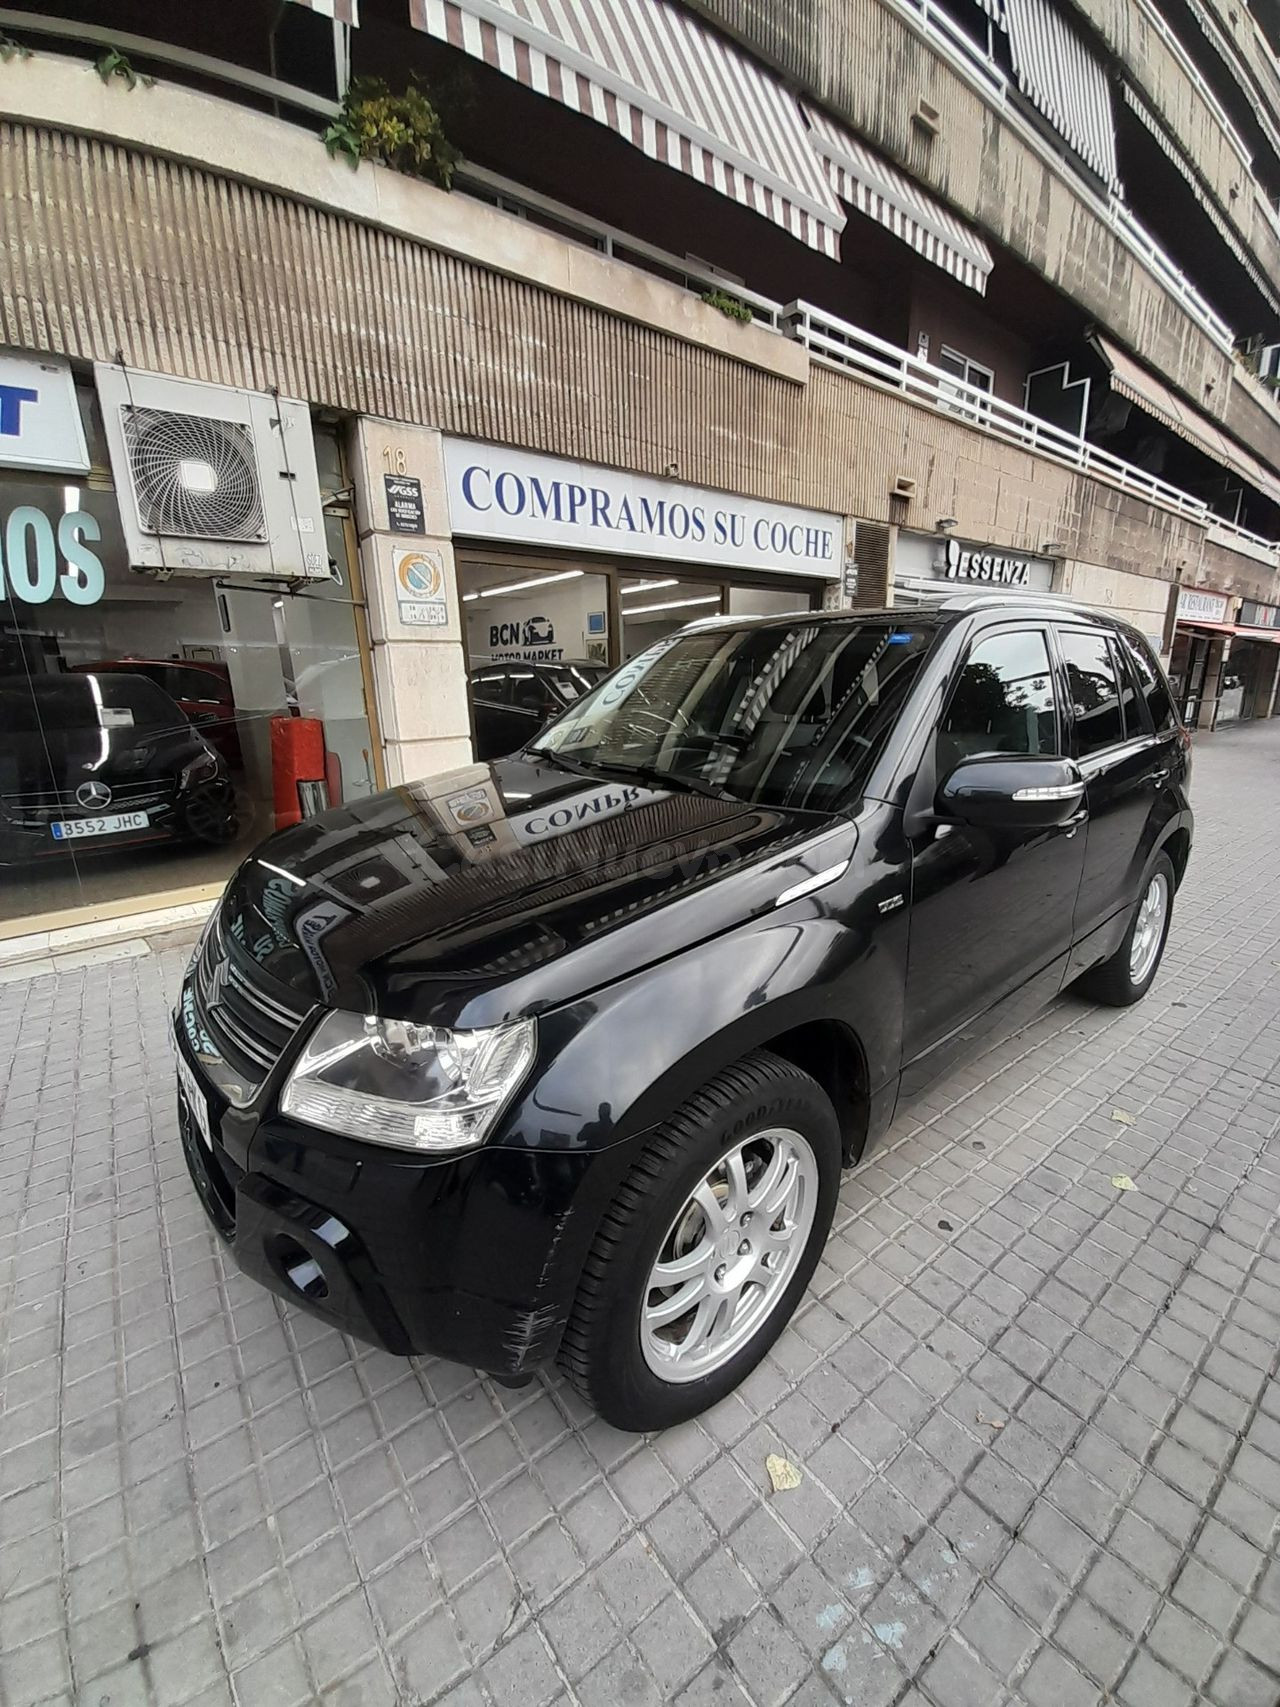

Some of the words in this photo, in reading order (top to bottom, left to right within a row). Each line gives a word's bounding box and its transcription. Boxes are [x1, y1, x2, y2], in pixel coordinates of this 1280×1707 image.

[383, 445, 407, 475] 18
[461, 465, 707, 543] COMPRAMOS
[713, 510, 747, 549] SU
[753, 517, 834, 561] COCHE
[957, 551, 1030, 585] ESSENZA
[489, 622, 520, 647] BCN
[113, 814, 142, 830] JHC
